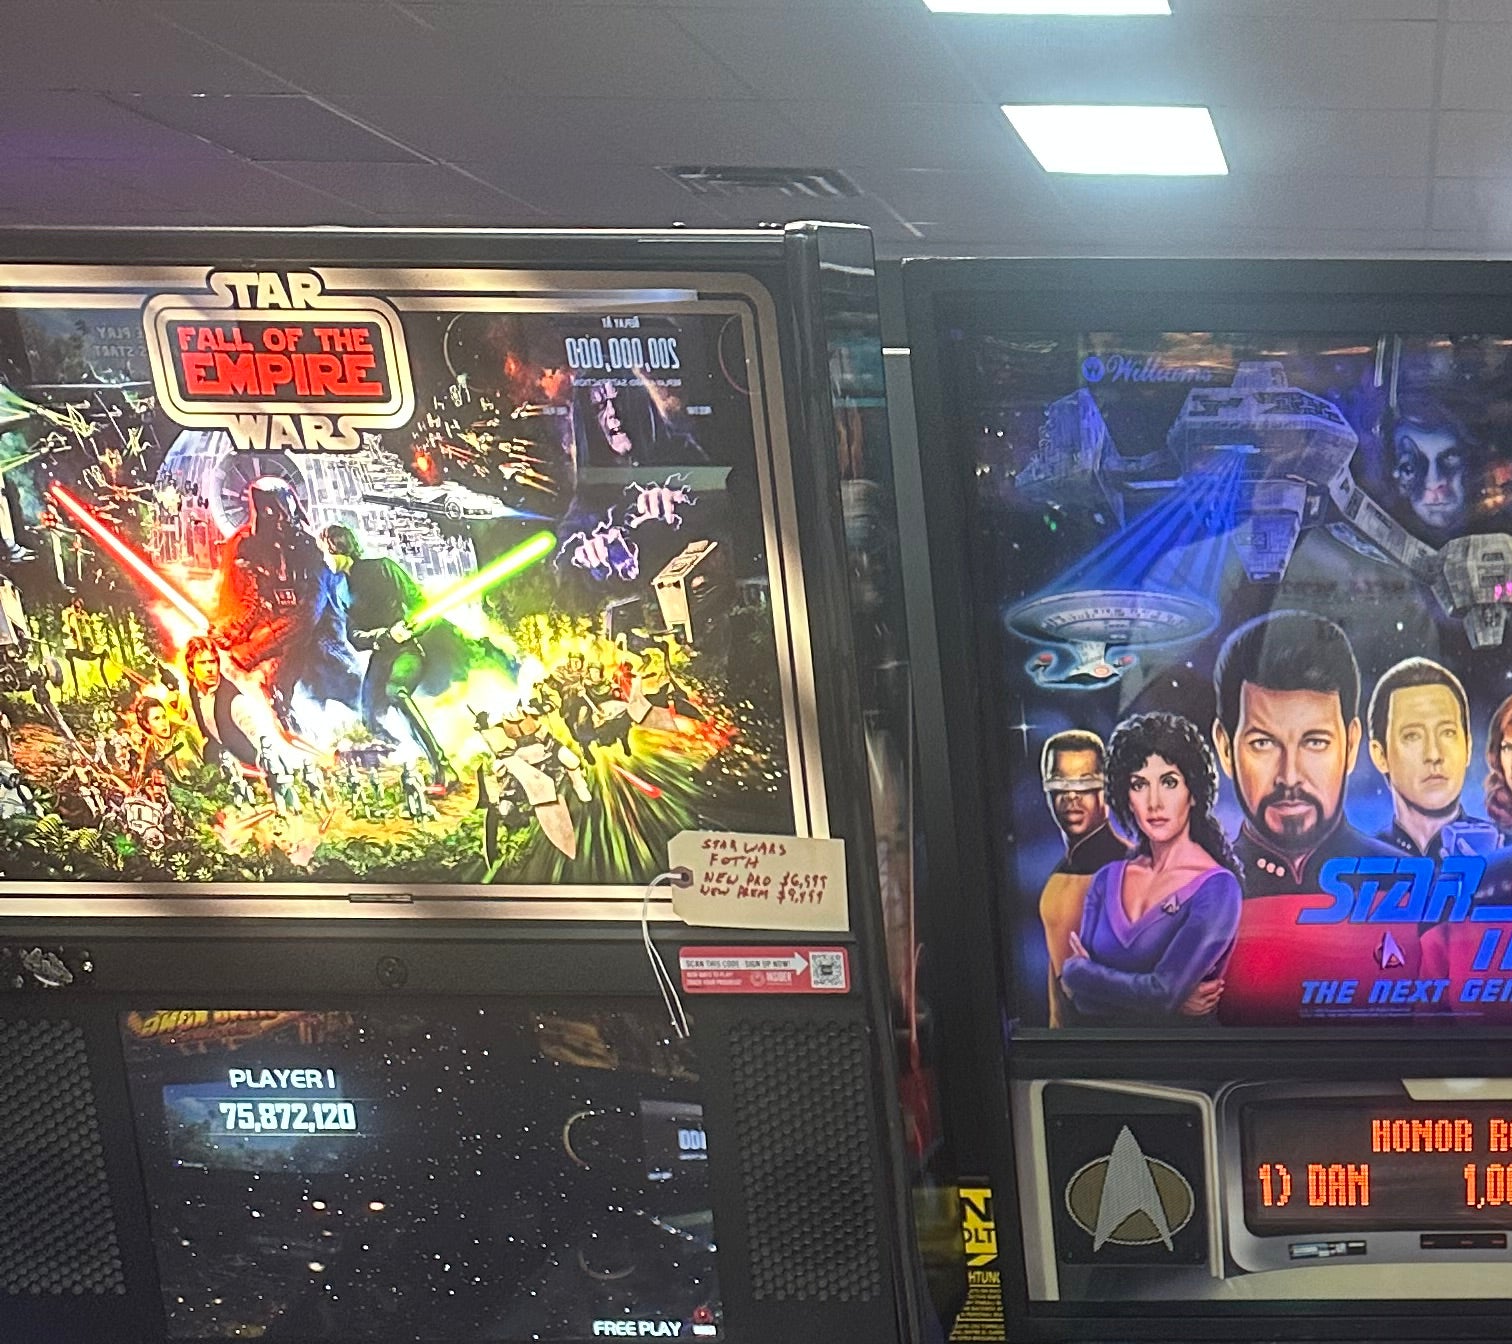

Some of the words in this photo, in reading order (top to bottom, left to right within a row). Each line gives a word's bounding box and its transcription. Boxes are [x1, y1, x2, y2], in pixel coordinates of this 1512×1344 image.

[209, 271, 324, 309] STAR
[177, 327, 255, 352] FALL
[262, 327, 304, 352] OF
[313, 328, 374, 352] THE
[180, 353, 384, 396] EMPIRE
[228, 414, 361, 451] WARS
[701, 838, 737, 853] STAR
[743, 841, 787, 857] WARS
[700, 884, 730, 897] NEW
[704, 871, 739, 885] NEW
[1296, 855, 1488, 925] STAR
[1302, 979, 1359, 1004] THE
[1367, 979, 1451, 1004] NEXT
[229, 1069, 323, 1089] PLAYER
[219, 1102, 357, 1133] 75,872,120
[1372, 1119, 1473, 1153] HONOR
[1258, 1163, 1293, 1207] 1)
[1307, 1163, 1370, 1207] DAN
[592, 1320, 637, 1336] FREE
[638, 1320, 682, 1337] PLAY
